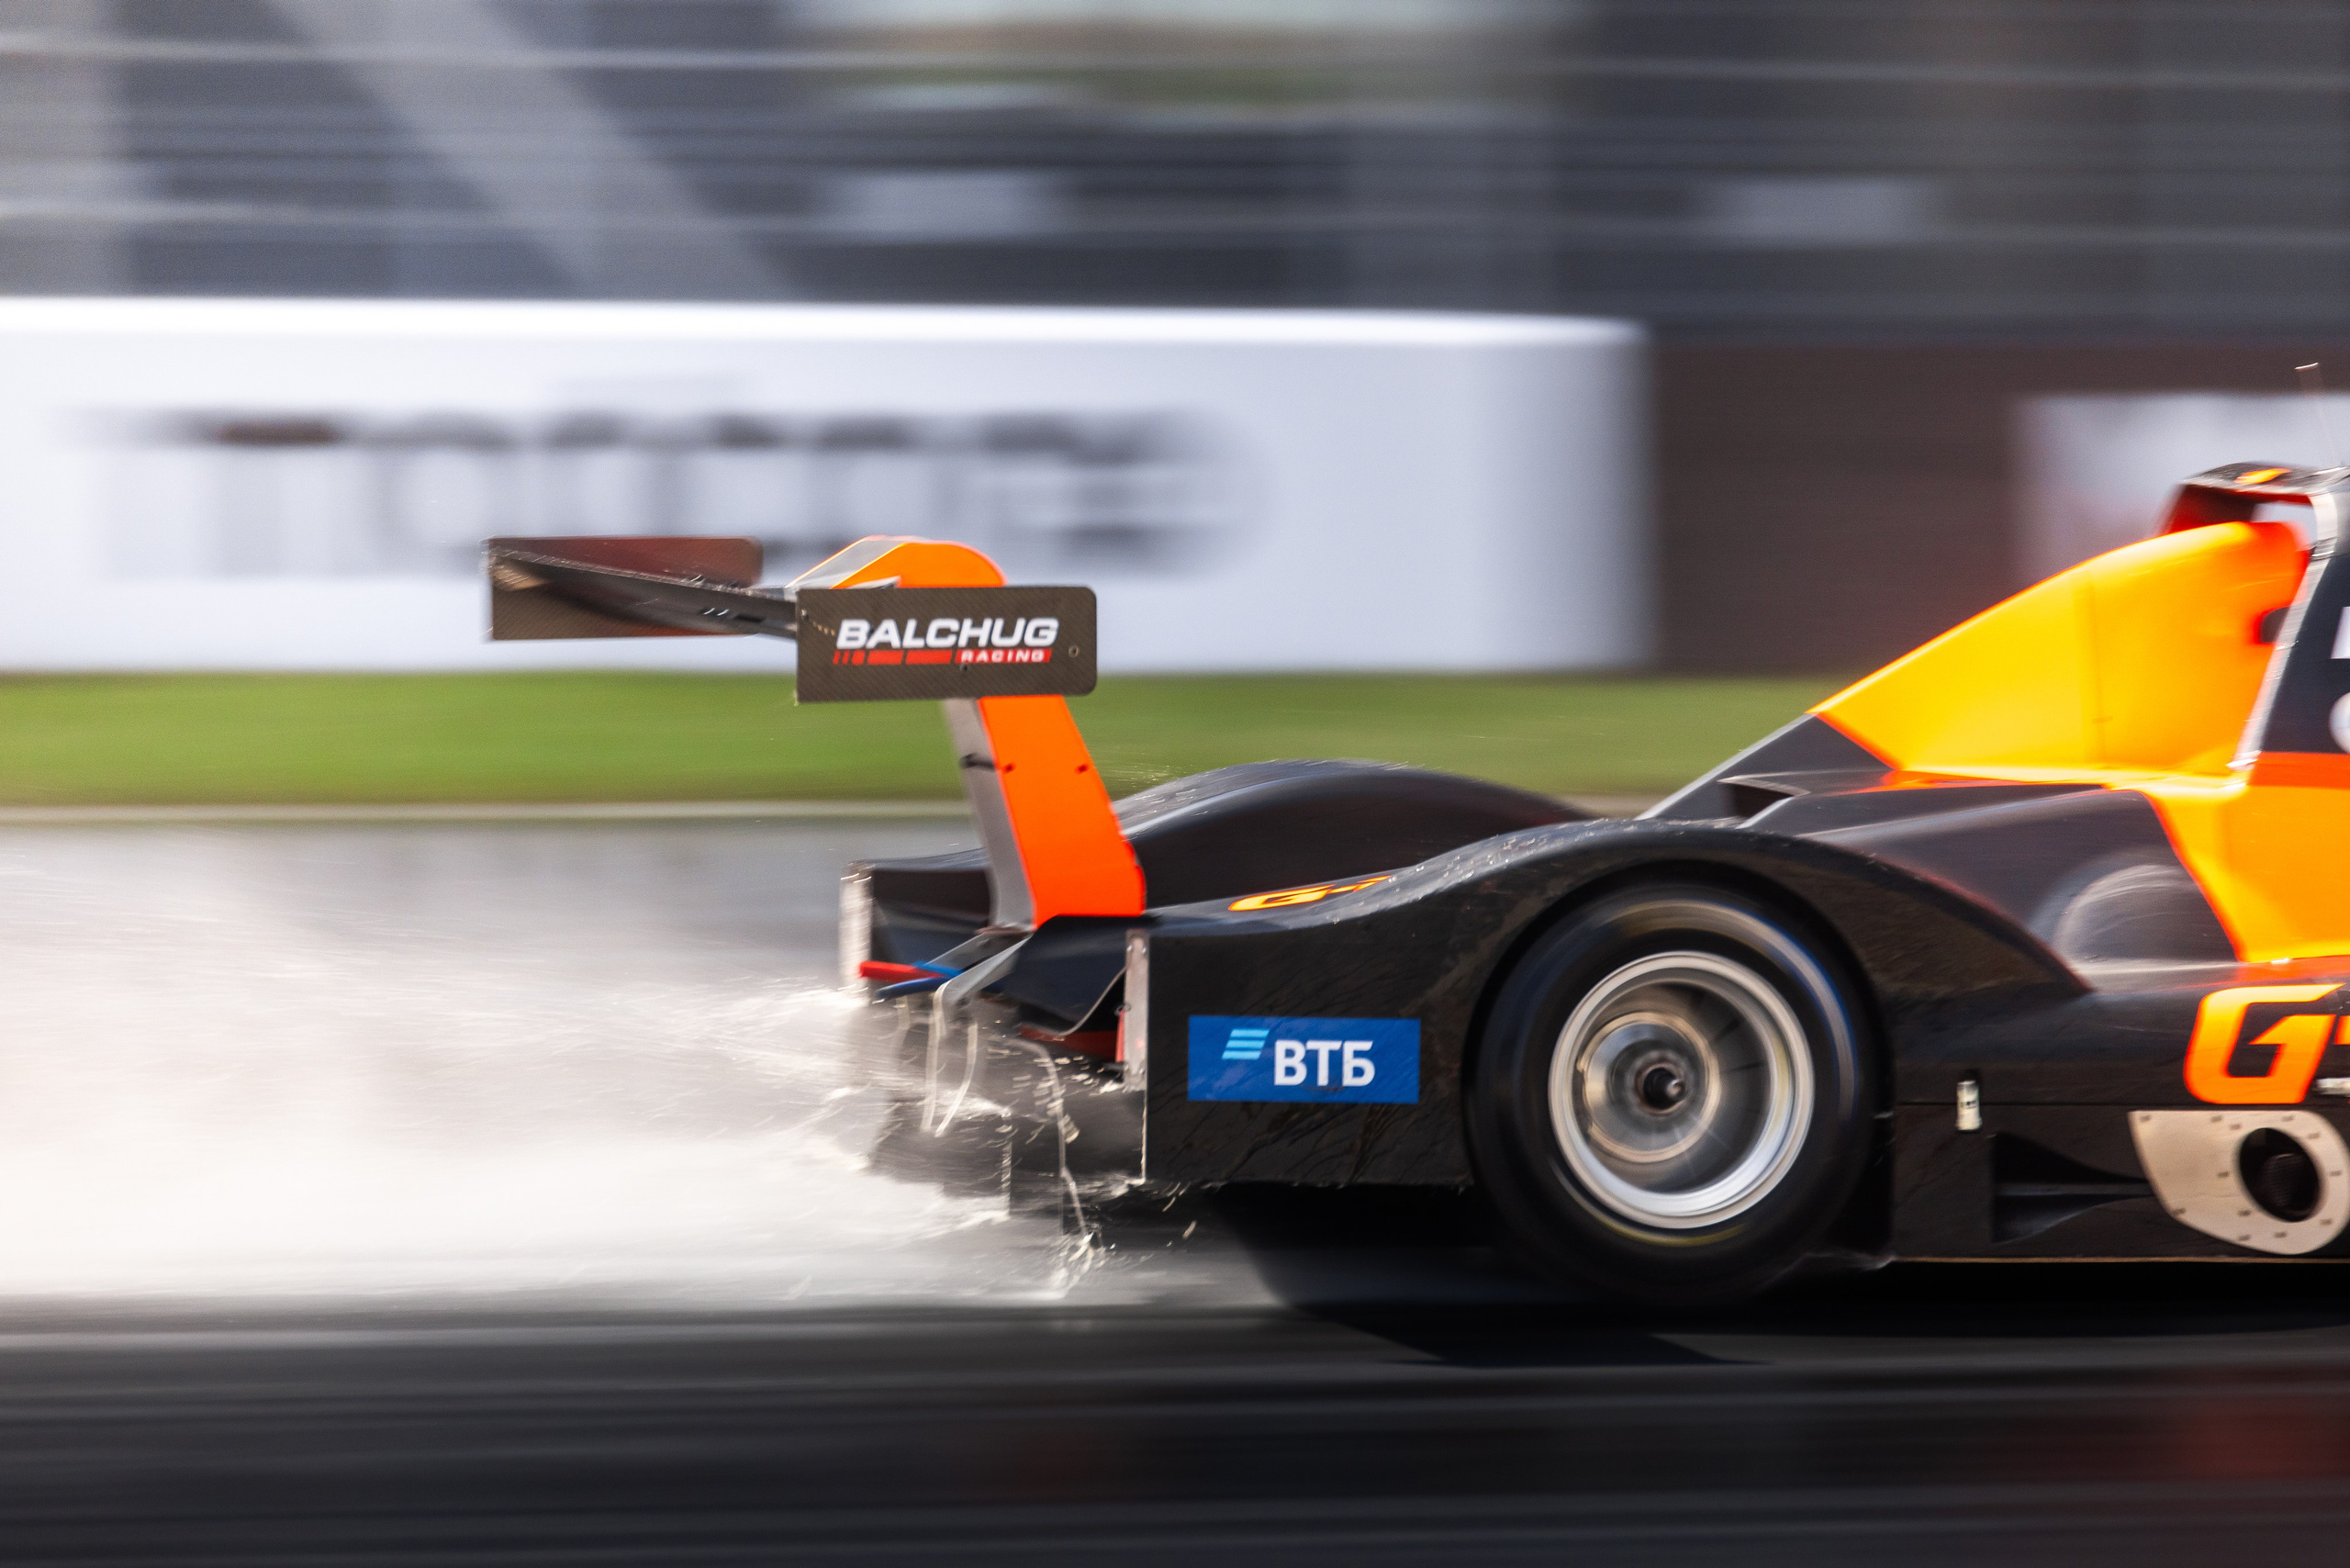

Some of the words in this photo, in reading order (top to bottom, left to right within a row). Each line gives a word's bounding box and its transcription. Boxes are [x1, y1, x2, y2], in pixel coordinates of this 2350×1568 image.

[835, 617, 1060, 649] BALCHUG
[960, 649, 1046, 663] RACING
[1273, 1039, 1376, 1087] ВТБ
